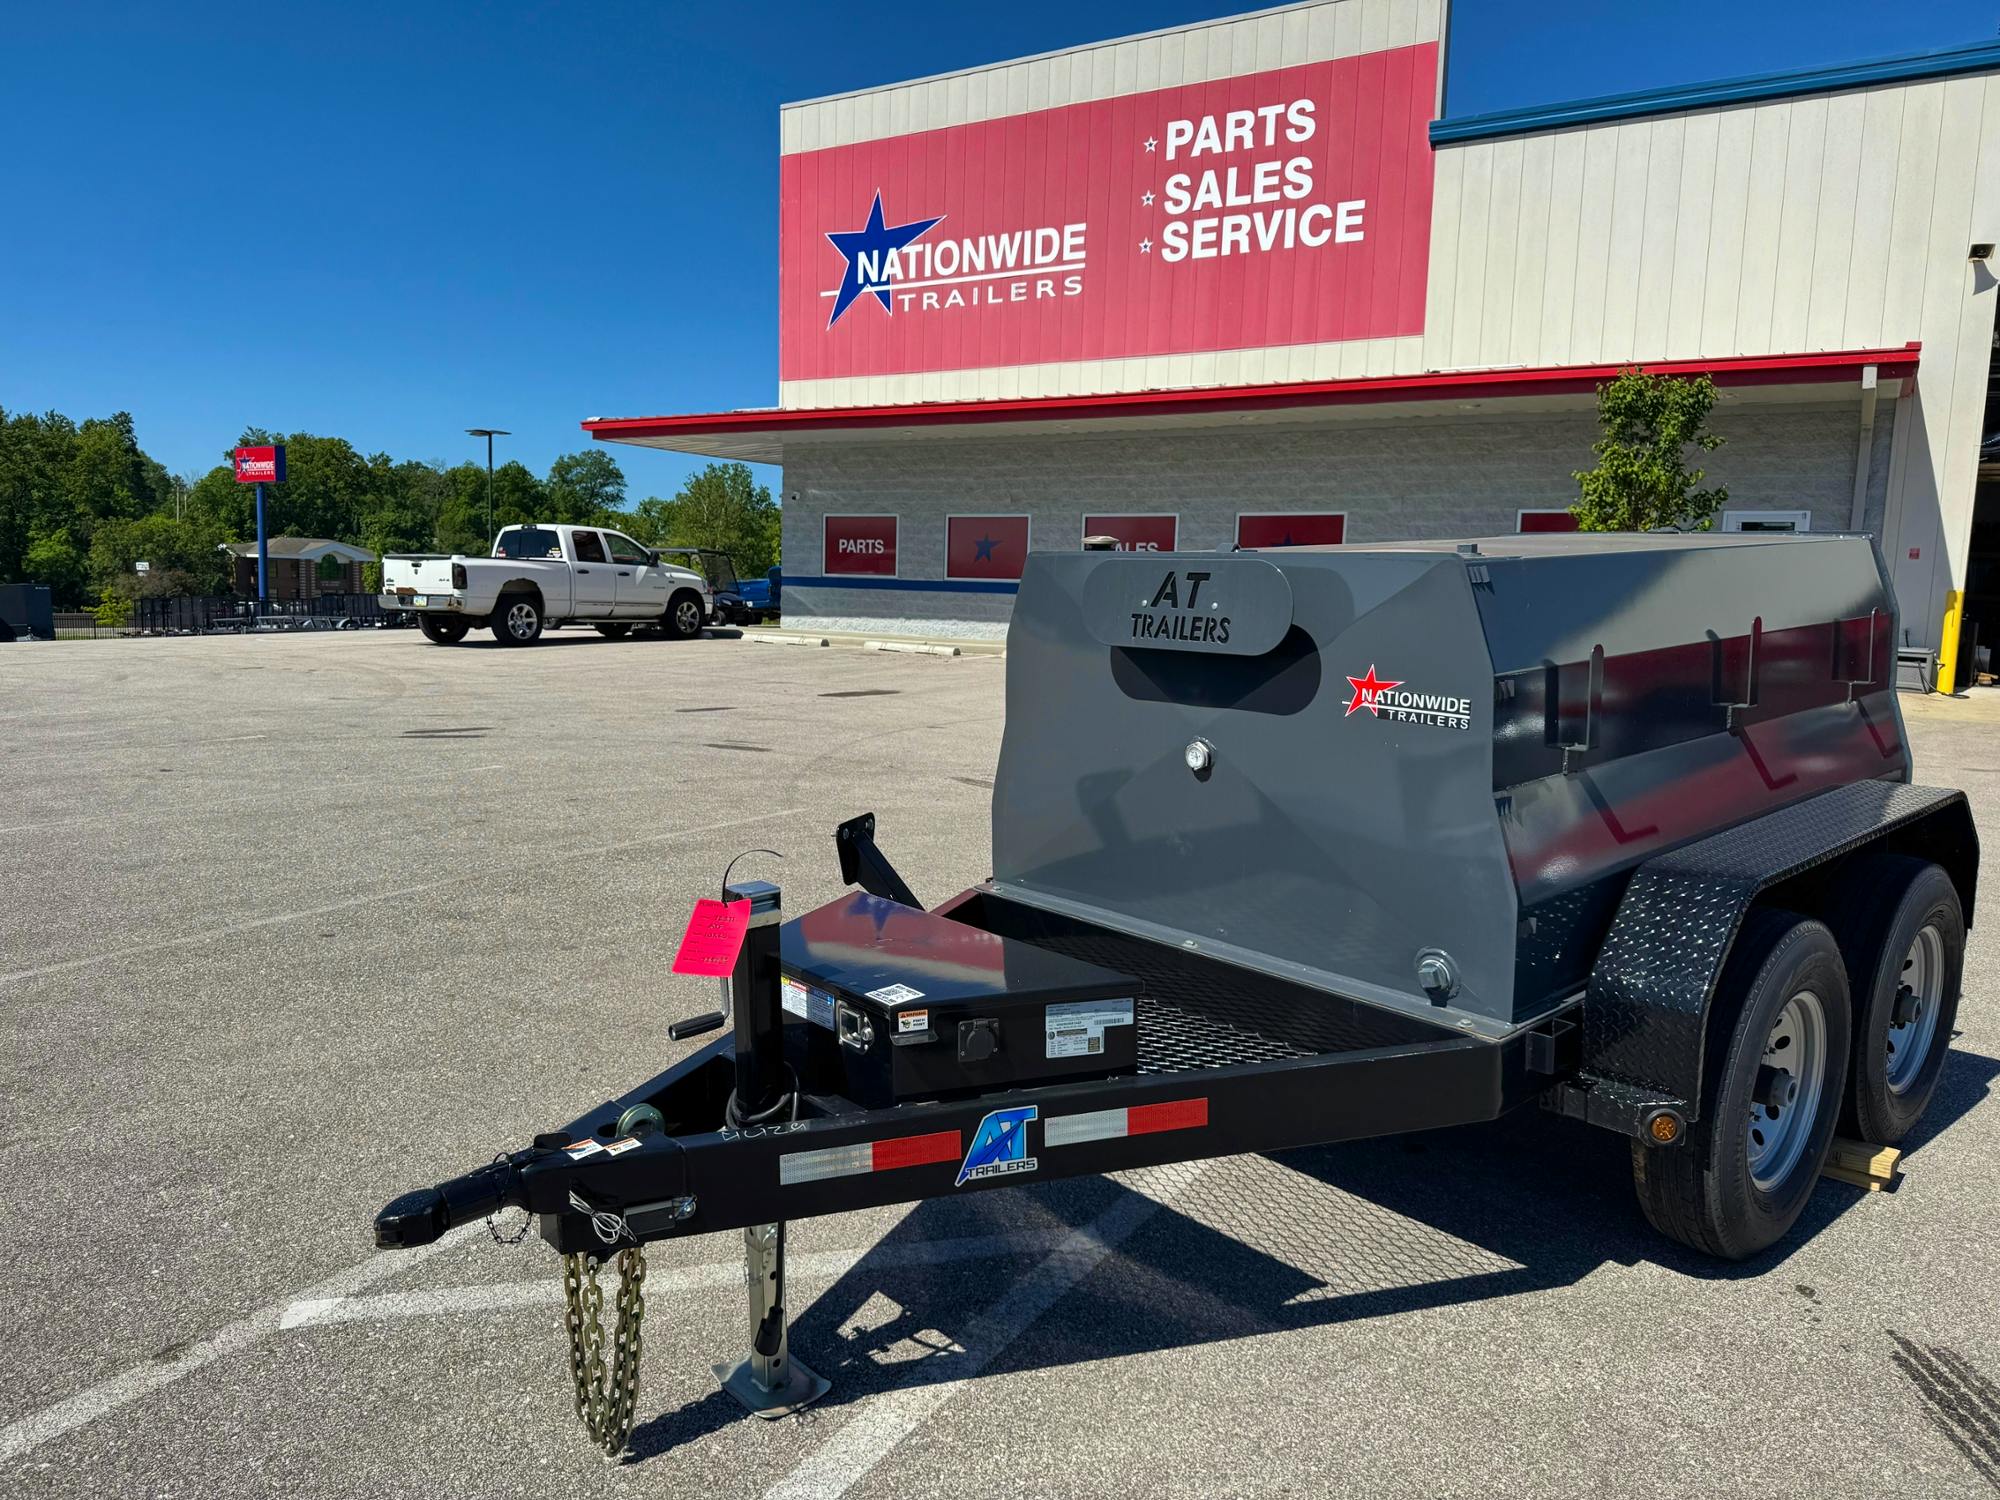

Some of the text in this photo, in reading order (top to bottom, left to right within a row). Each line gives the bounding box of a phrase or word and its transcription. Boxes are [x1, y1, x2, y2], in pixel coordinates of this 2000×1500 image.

[1165, 99, 1316, 161] PARTS
[1163, 156, 1313, 215] SALES
[1161, 200, 1366, 263] SERVICE
[857, 223, 1087, 285] NATIONWIDE
[897, 276, 1083, 312] TRAILERS
[838, 538, 885, 554] PARTS
[1150, 571, 1211, 609] AT
[1131, 613, 1231, 644] TRAILERS
[1361, 687, 1471, 714] NATIONWIDE
[1387, 709, 1470, 730] TRAILERS
[964, 1106, 1036, 1168] AT
[966, 1160, 1036, 1178] TRAILERS
